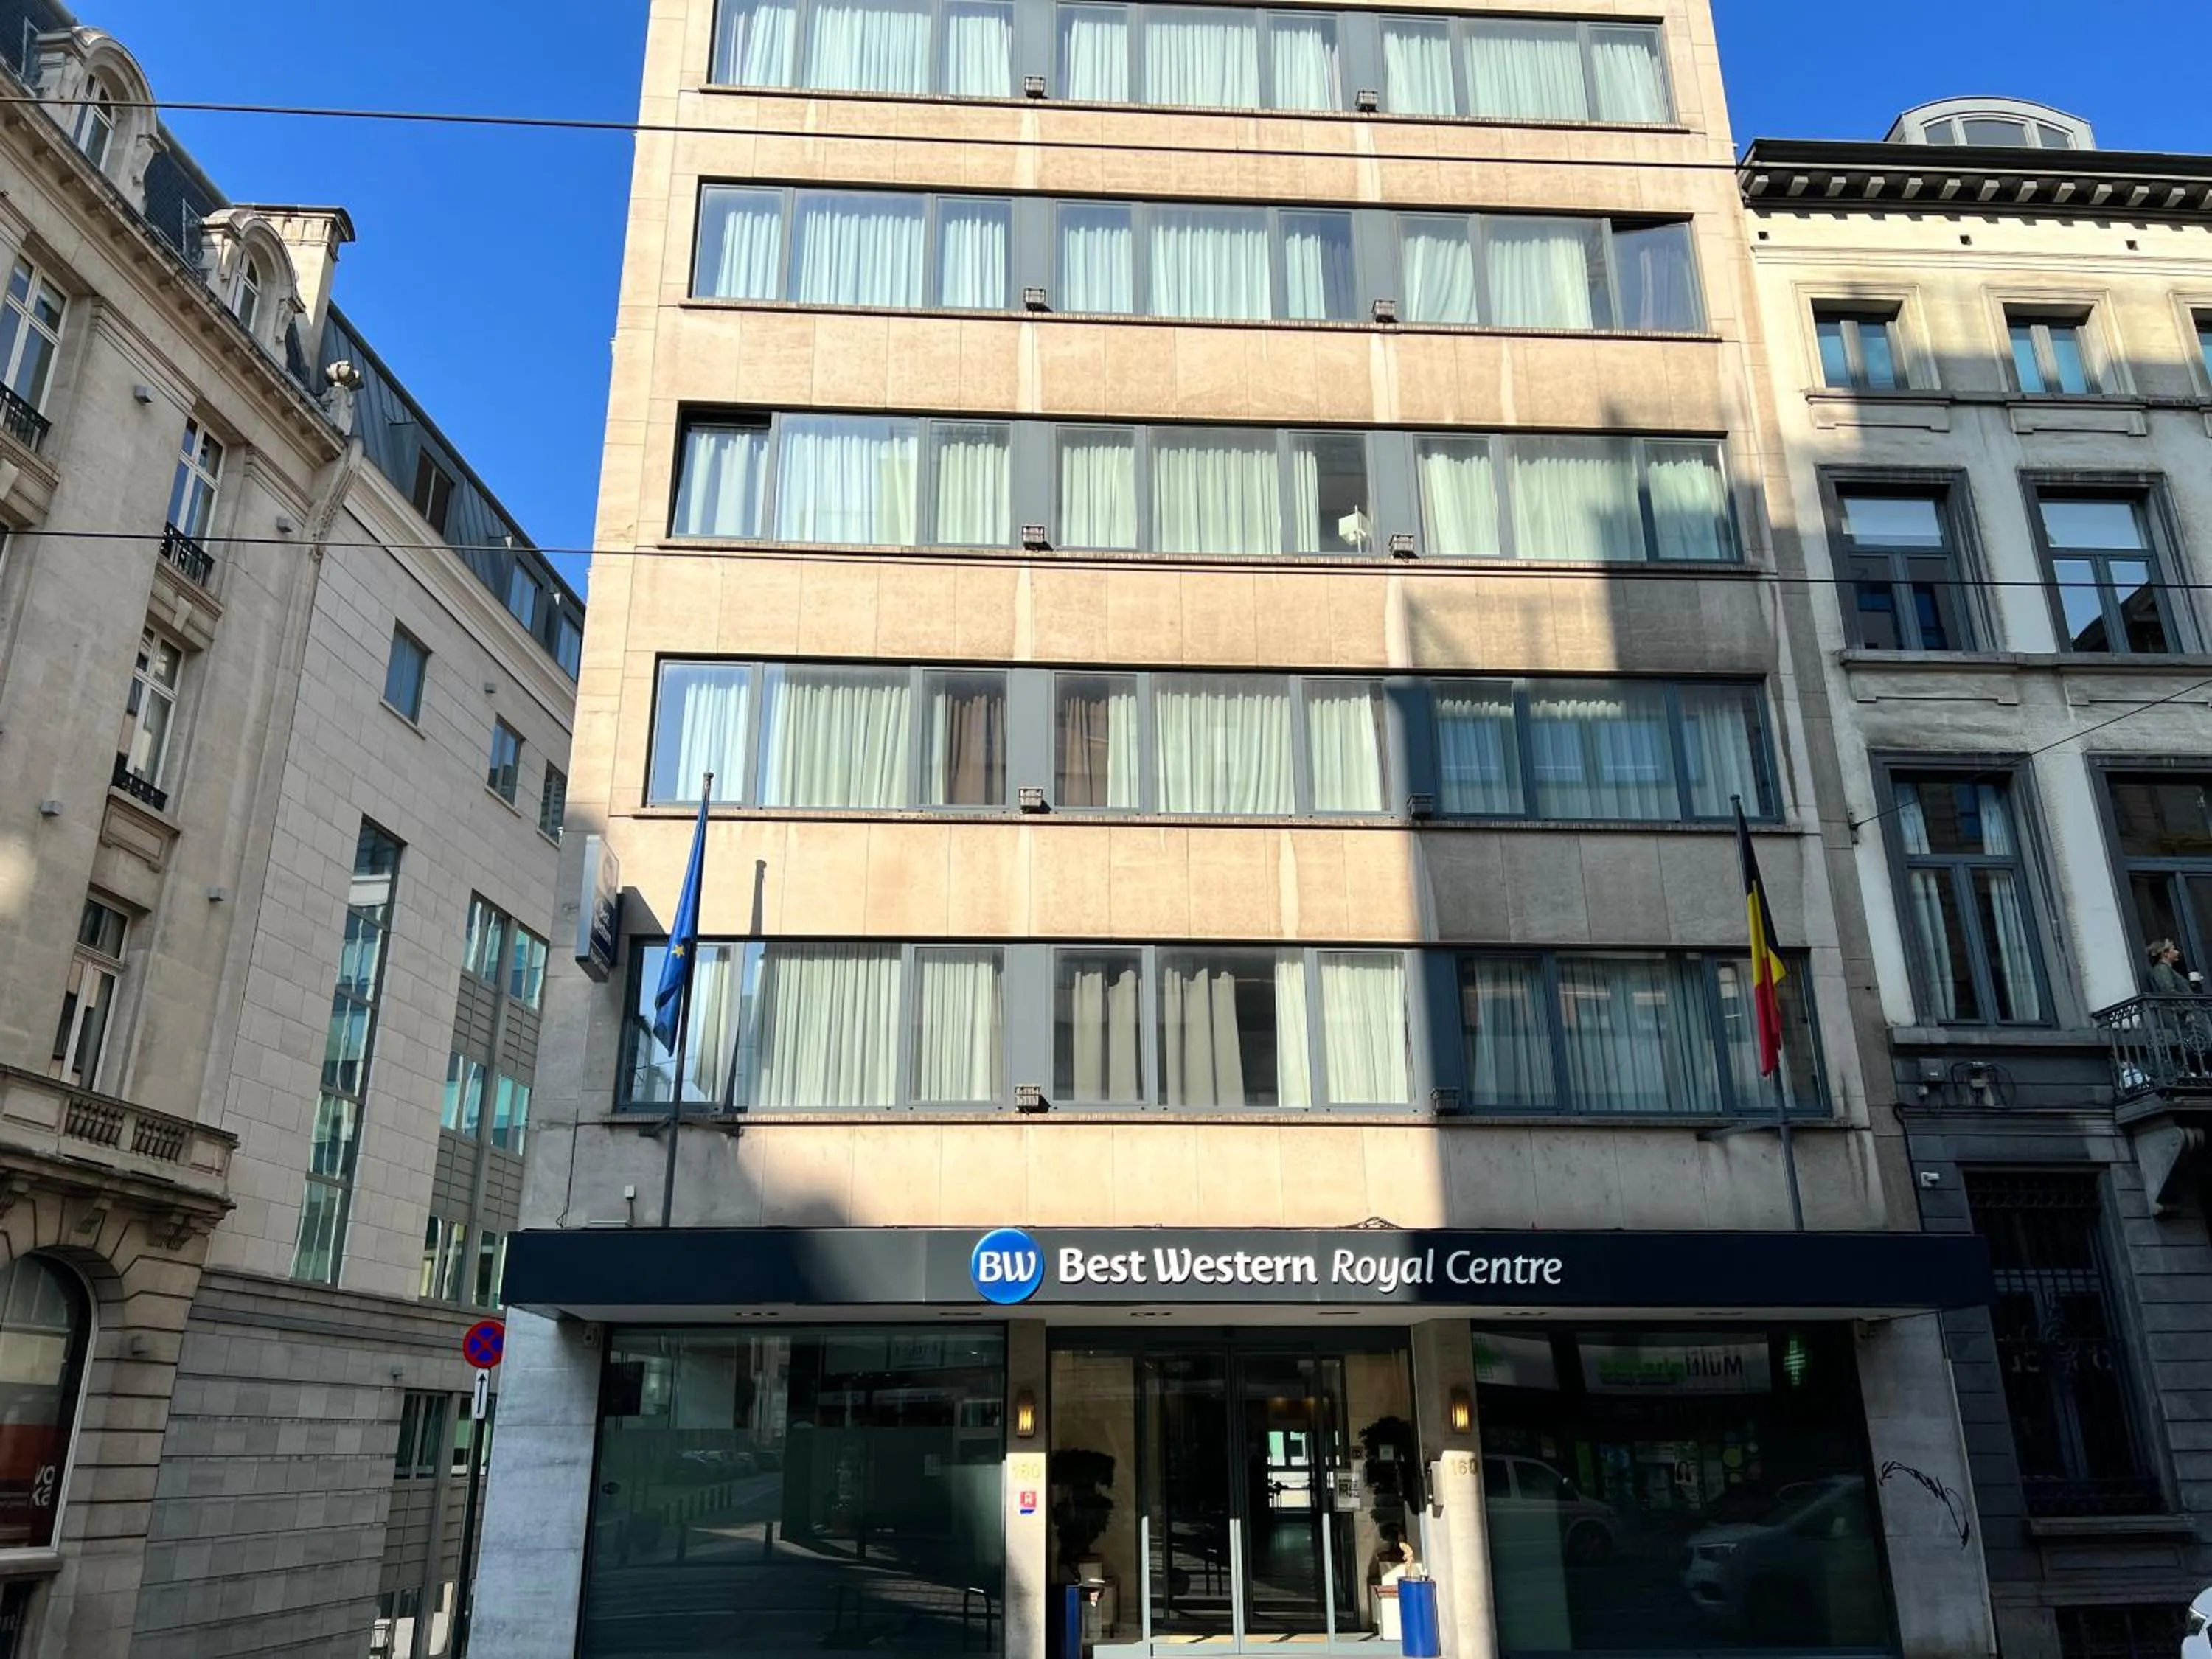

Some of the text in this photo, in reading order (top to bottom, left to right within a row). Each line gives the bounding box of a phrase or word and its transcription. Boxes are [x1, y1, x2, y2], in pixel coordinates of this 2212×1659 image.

[978, 1251, 1036, 1283] BW
[1059, 1247, 1562, 1293] Best Western Royal Centre
